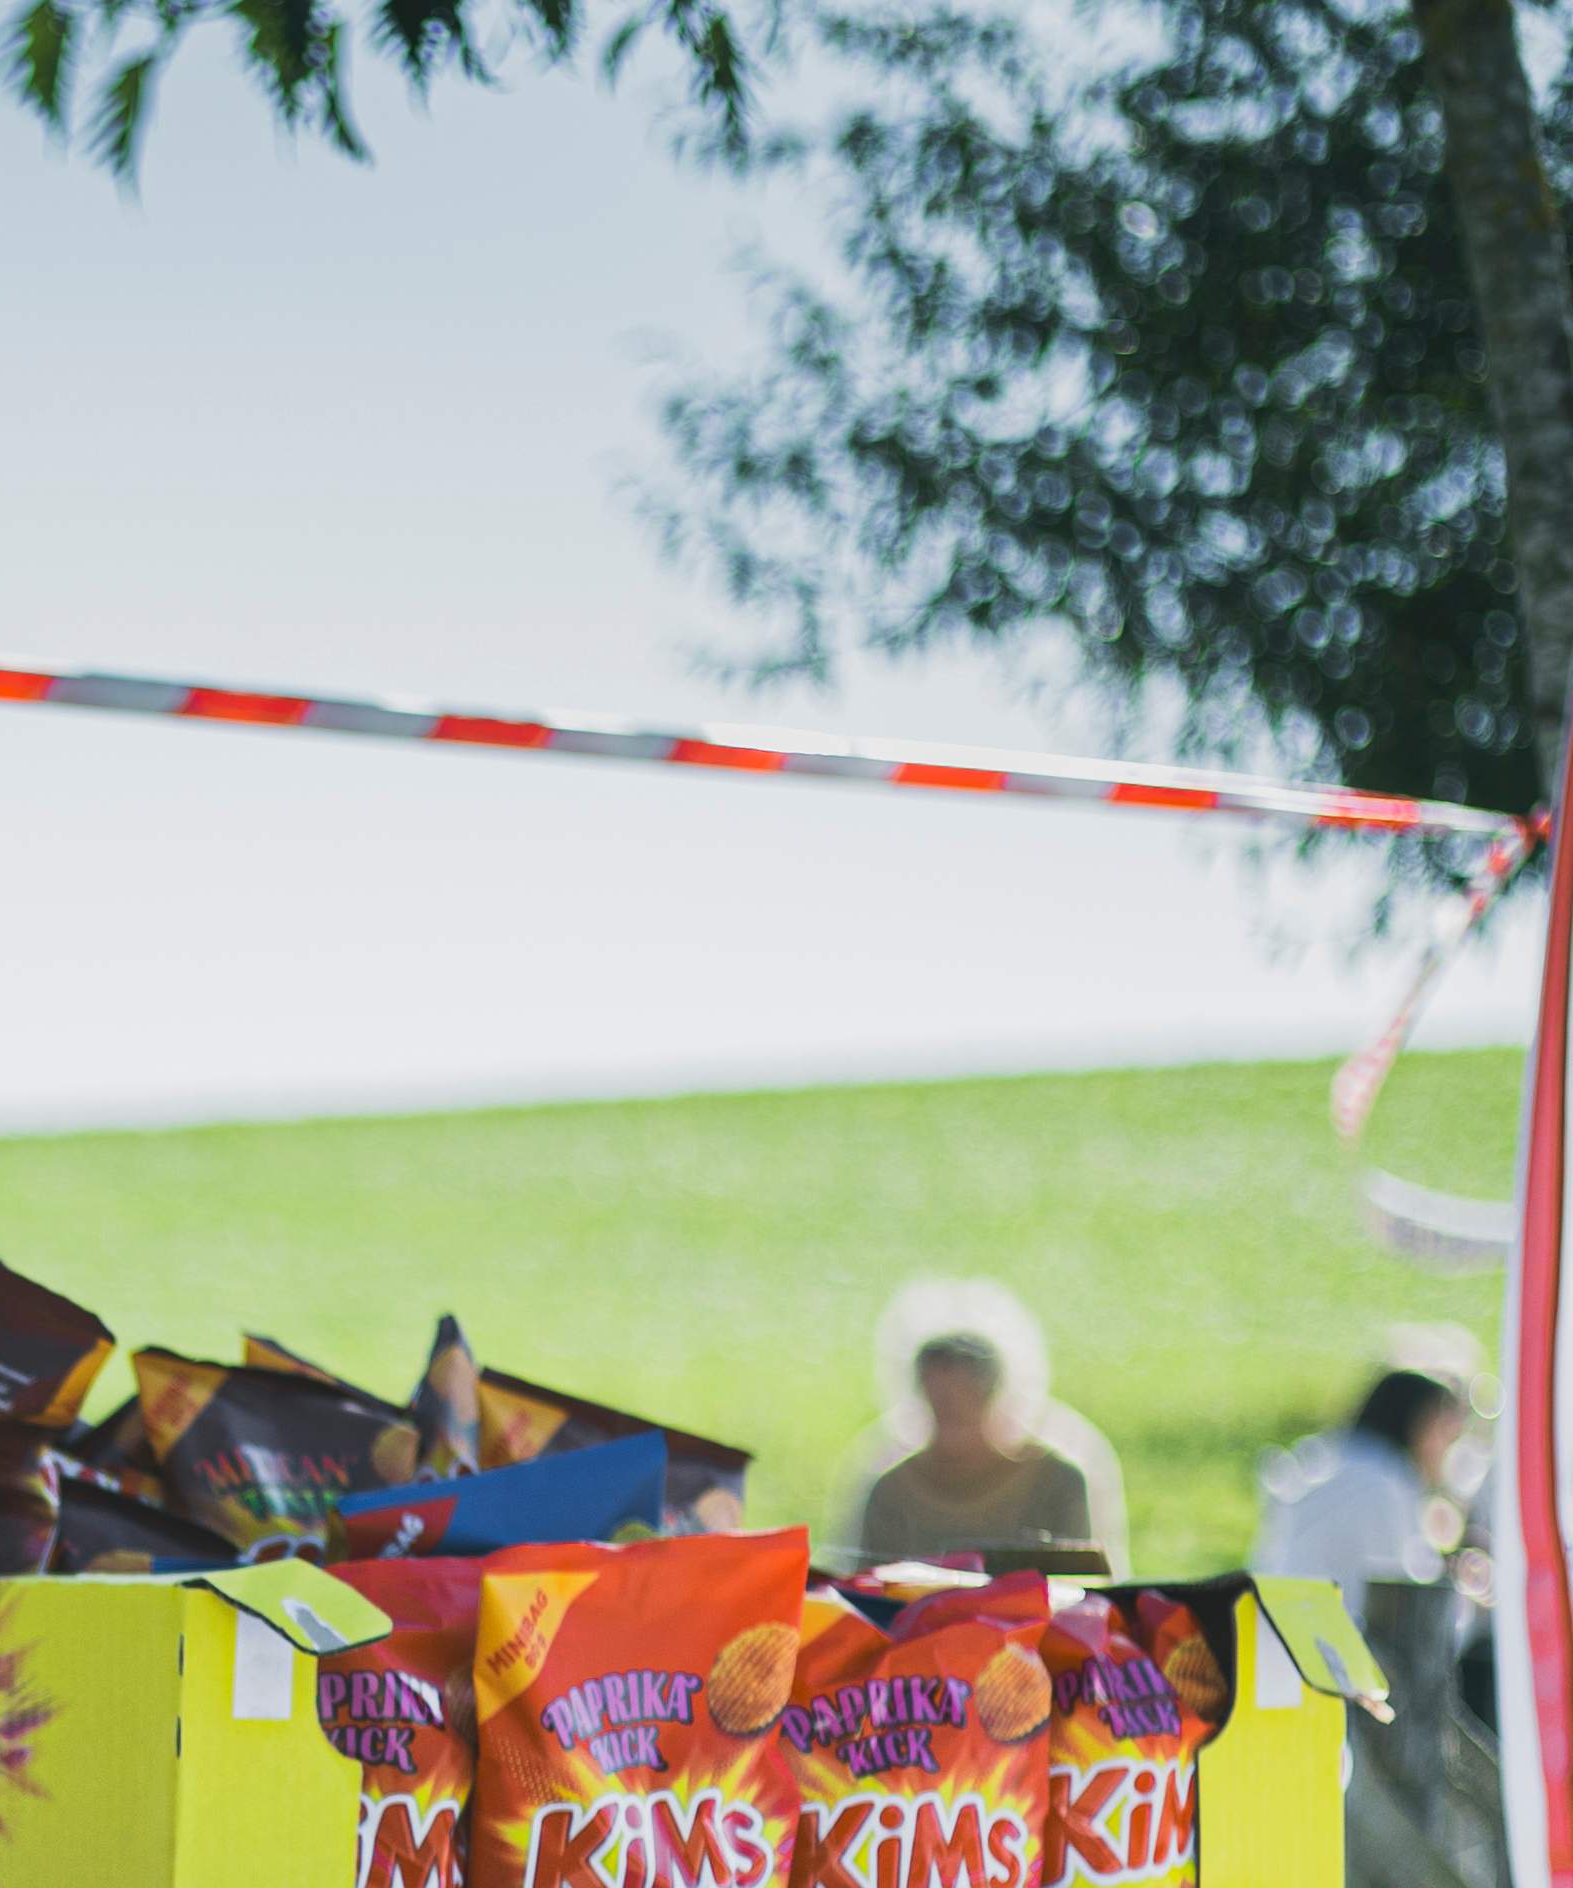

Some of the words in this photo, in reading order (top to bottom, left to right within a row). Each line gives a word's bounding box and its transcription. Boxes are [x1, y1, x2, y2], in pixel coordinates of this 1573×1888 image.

[541, 1670, 703, 1750] PAPRIKA
[781, 1676, 973, 1753] PAPRIKA
[590, 1725, 668, 1774] KICK
[838, 1728, 940, 1777] KICK
